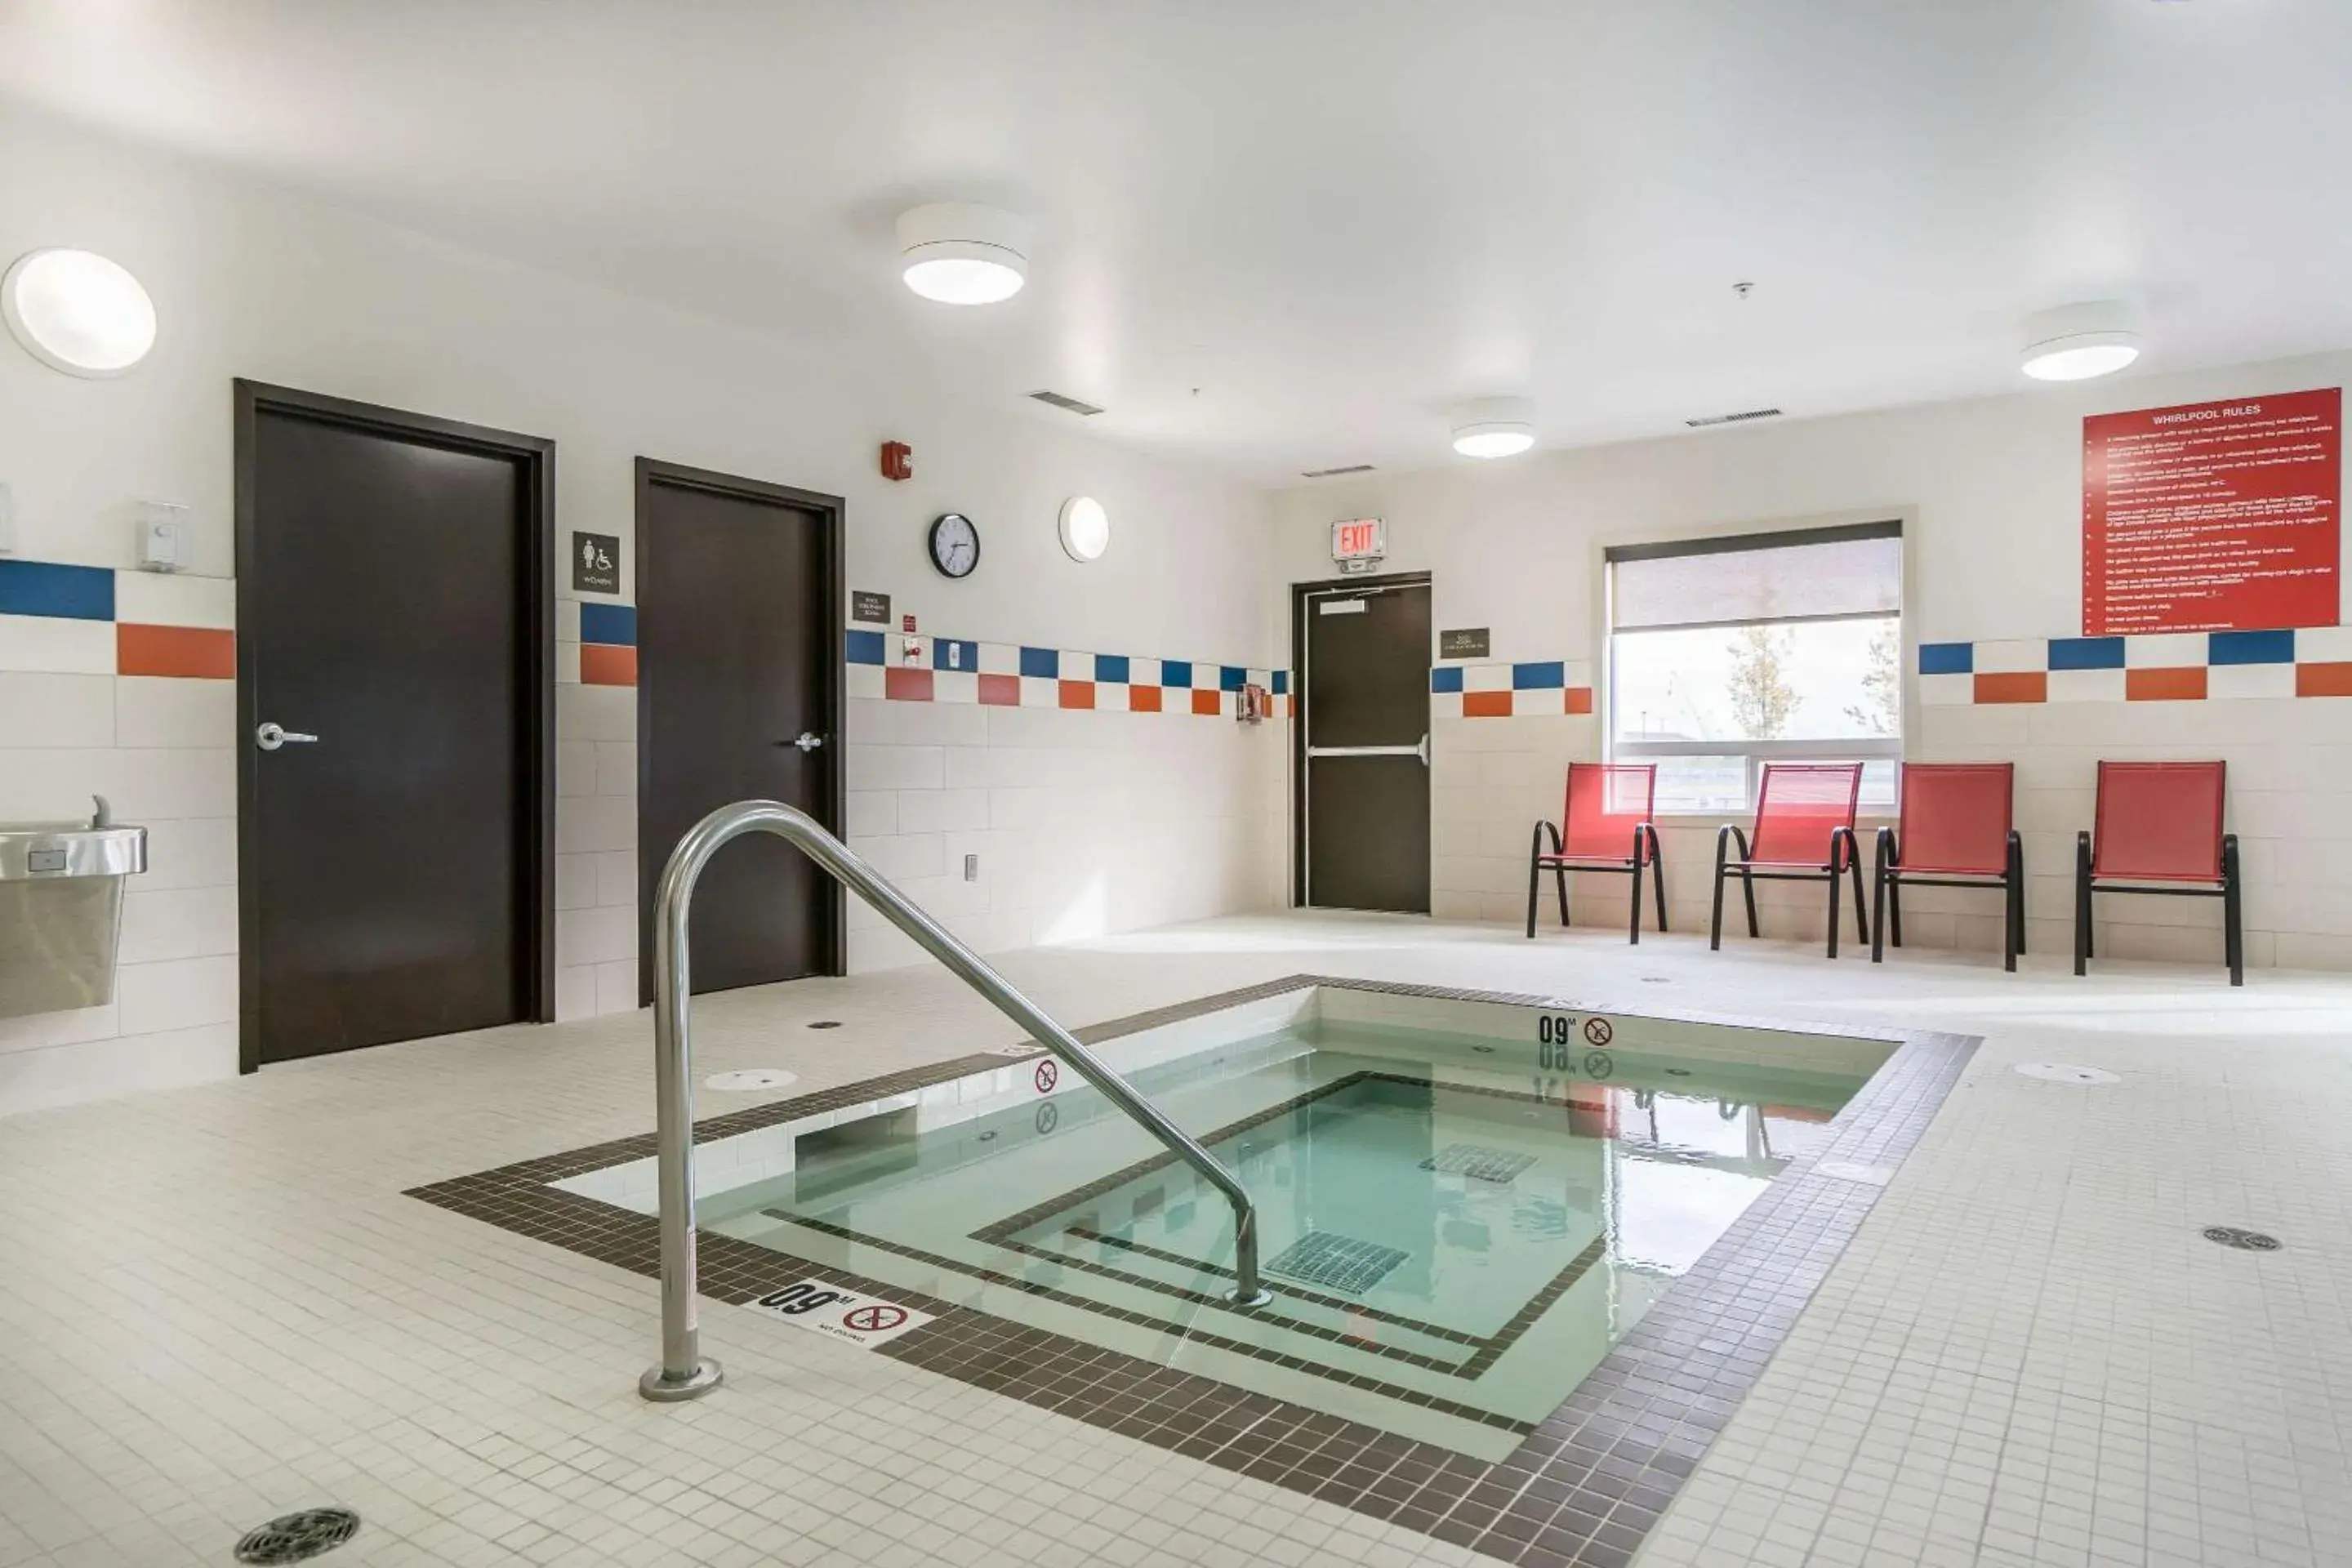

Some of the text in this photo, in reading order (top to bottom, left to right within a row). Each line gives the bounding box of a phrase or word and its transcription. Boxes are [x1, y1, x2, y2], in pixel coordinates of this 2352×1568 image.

[2152, 410, 2221, 425] WHIRLPOOL
[2222, 404, 2261, 417] RULES
[1342, 524, 1373, 552] EXIT
